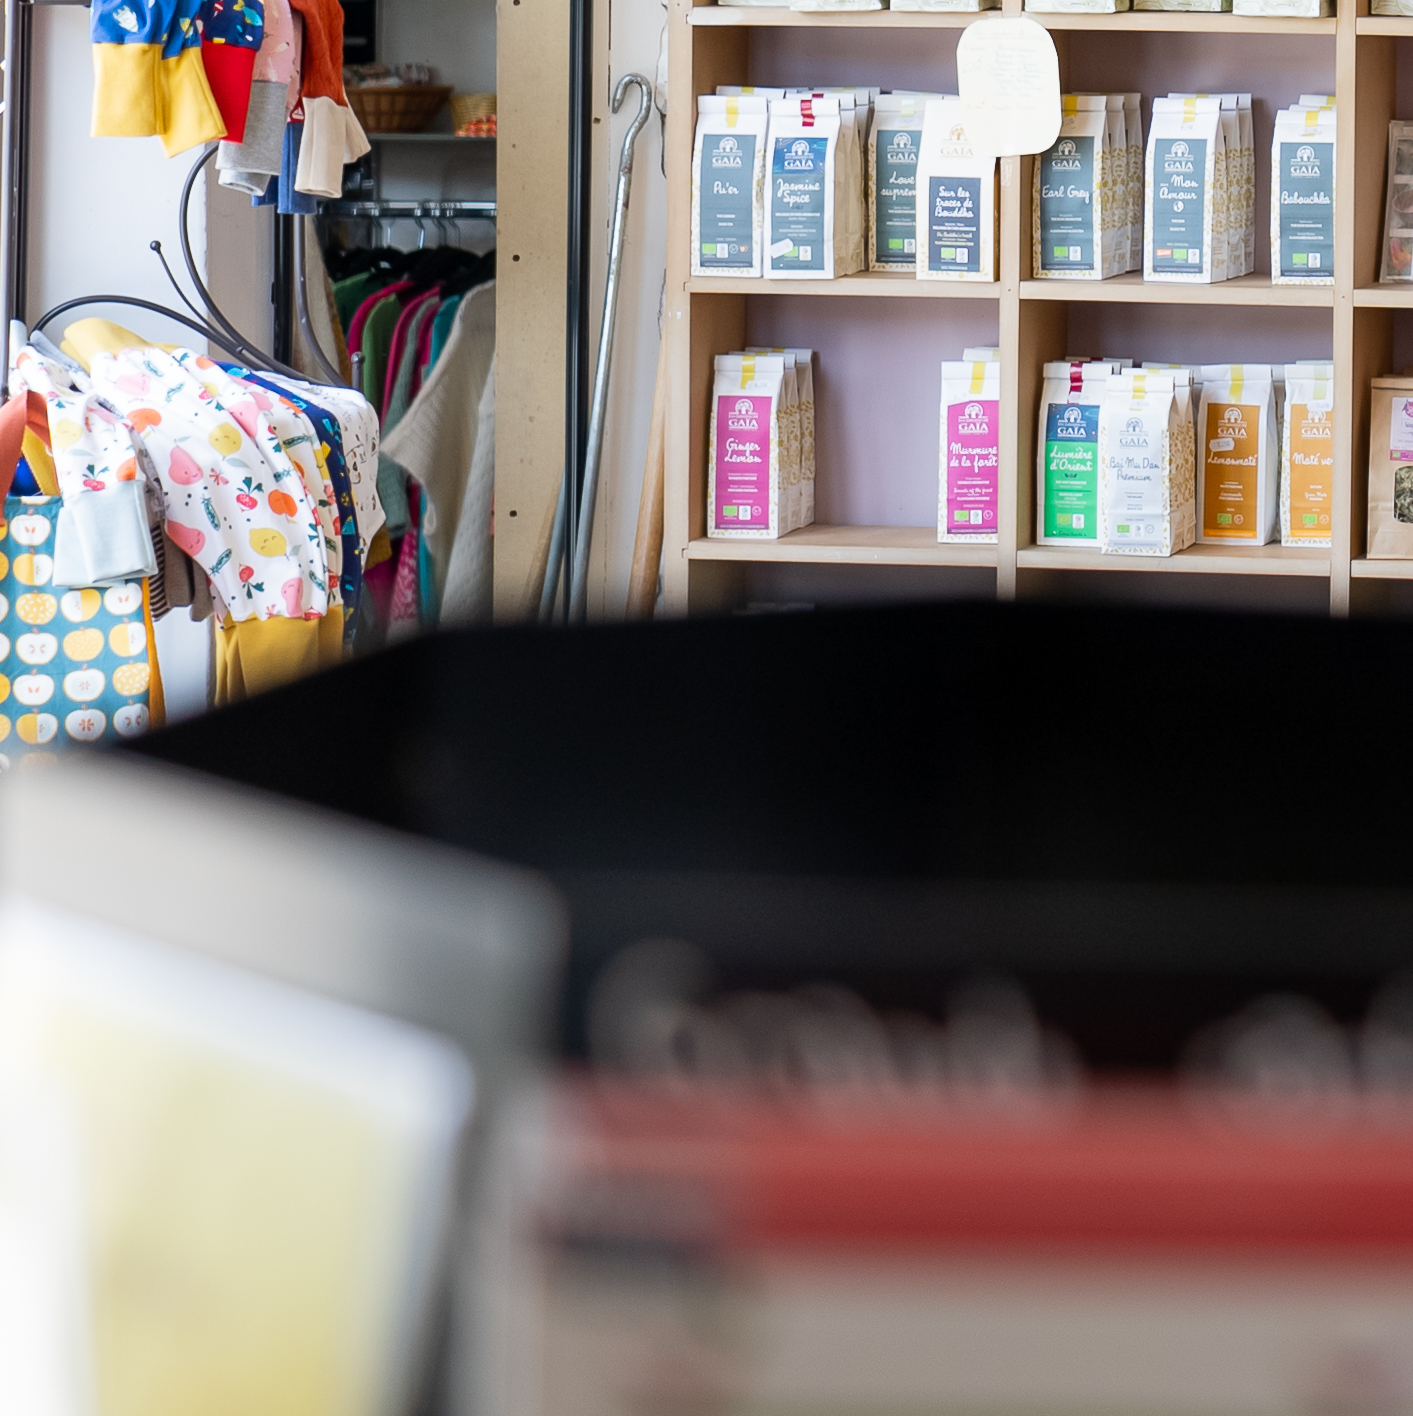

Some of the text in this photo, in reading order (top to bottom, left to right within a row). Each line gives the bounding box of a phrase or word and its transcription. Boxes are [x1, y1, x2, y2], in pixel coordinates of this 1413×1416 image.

[887, 151, 917, 161] GAÏA
[940, 146, 974, 157] GAÏA
[712, 156, 742, 166] GAÏA
[784, 158, 814, 168] GAÏA
[1052, 158, 1082, 169] GAÏA
[1164, 160, 1194, 170] GAÏA
[1291, 164, 1320, 174] GAÏA
[889, 170, 916, 185] Love
[1170, 174, 1198, 188] Mon
[713, 180, 739, 195] Pu'er
[776, 178, 821, 197] Jasmine
[938, 185, 970, 198] Sur les
[1159, 187, 1198, 200] Amour
[783, 189, 811, 204] Spice
[1042, 184, 1090, 204] Earl Grey
[1281, 190, 1330, 204] Babouchka
[936, 197, 973, 208] traces de
[934, 207, 974, 218] Bouddha
[728, 419, 758, 429] GAÏA
[959, 422, 988, 431] GAÏA
[1057, 427, 1086, 437] GAÏA
[1218, 427, 1247, 438] GAÏA
[1301, 428, 1331, 438] GAÏA
[726, 438, 760, 453] Ginger
[950, 442, 998, 454] Murmure
[1119, 437, 1148, 447] GAÏA
[724, 451, 762, 463] Lemon
[1050, 444, 1093, 459] Lumière
[950, 454, 998, 473] de la forêt
[1293, 451, 1319, 465] Maté
[1050, 459, 1093, 472] d'Orient
